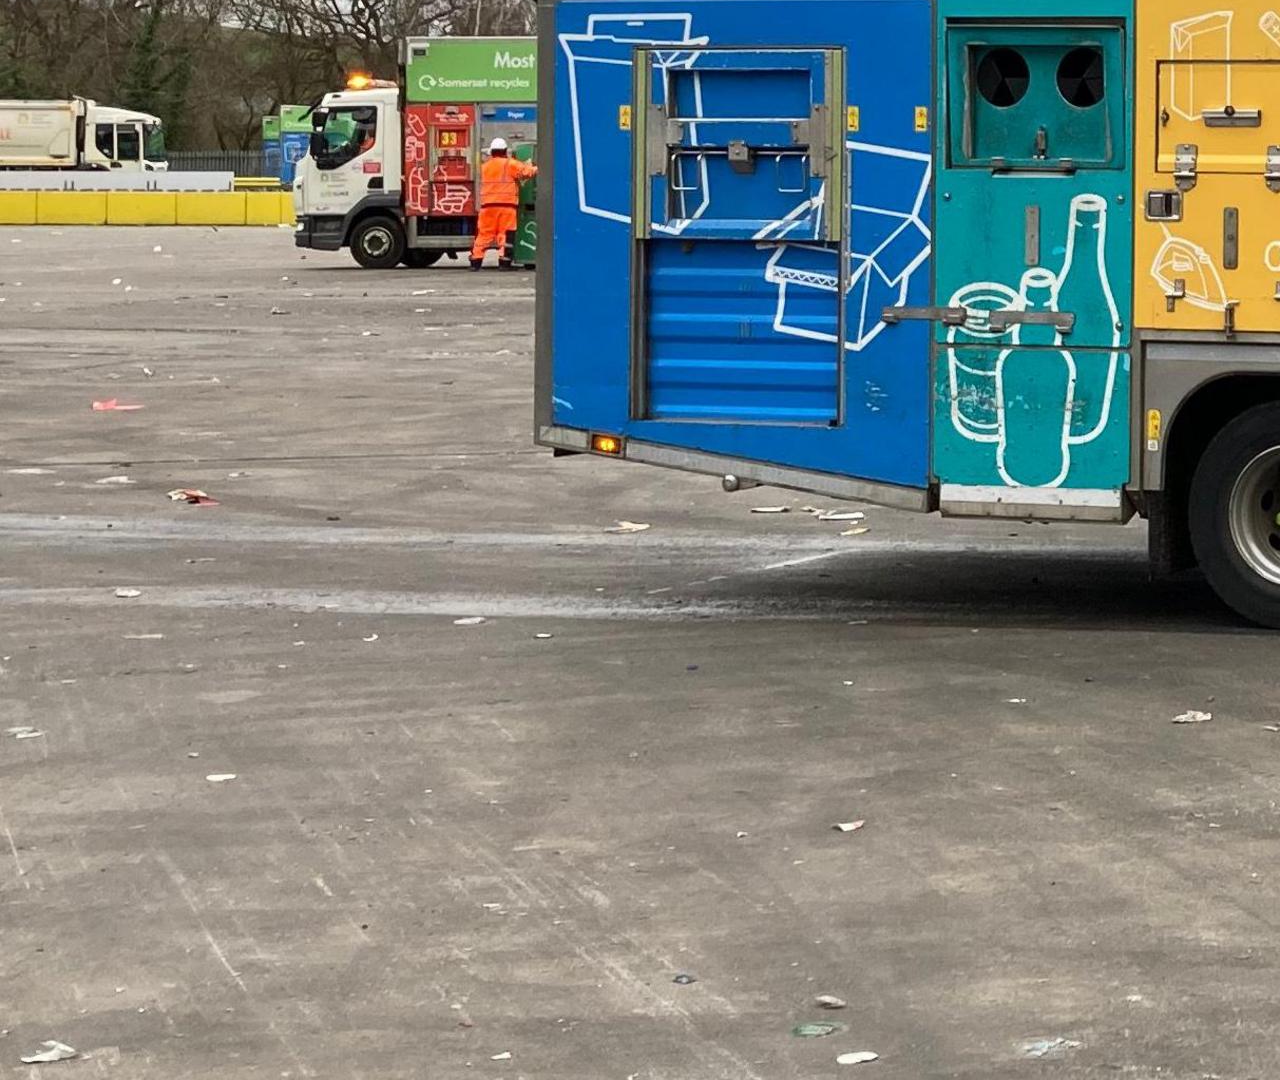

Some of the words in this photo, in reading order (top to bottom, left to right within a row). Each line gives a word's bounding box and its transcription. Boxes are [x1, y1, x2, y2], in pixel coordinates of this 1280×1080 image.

[494, 50, 536, 69] Most
[438, 76, 488, 89] Somerset
[490, 77, 530, 90] recycles
[441, 131, 457, 146] 33
